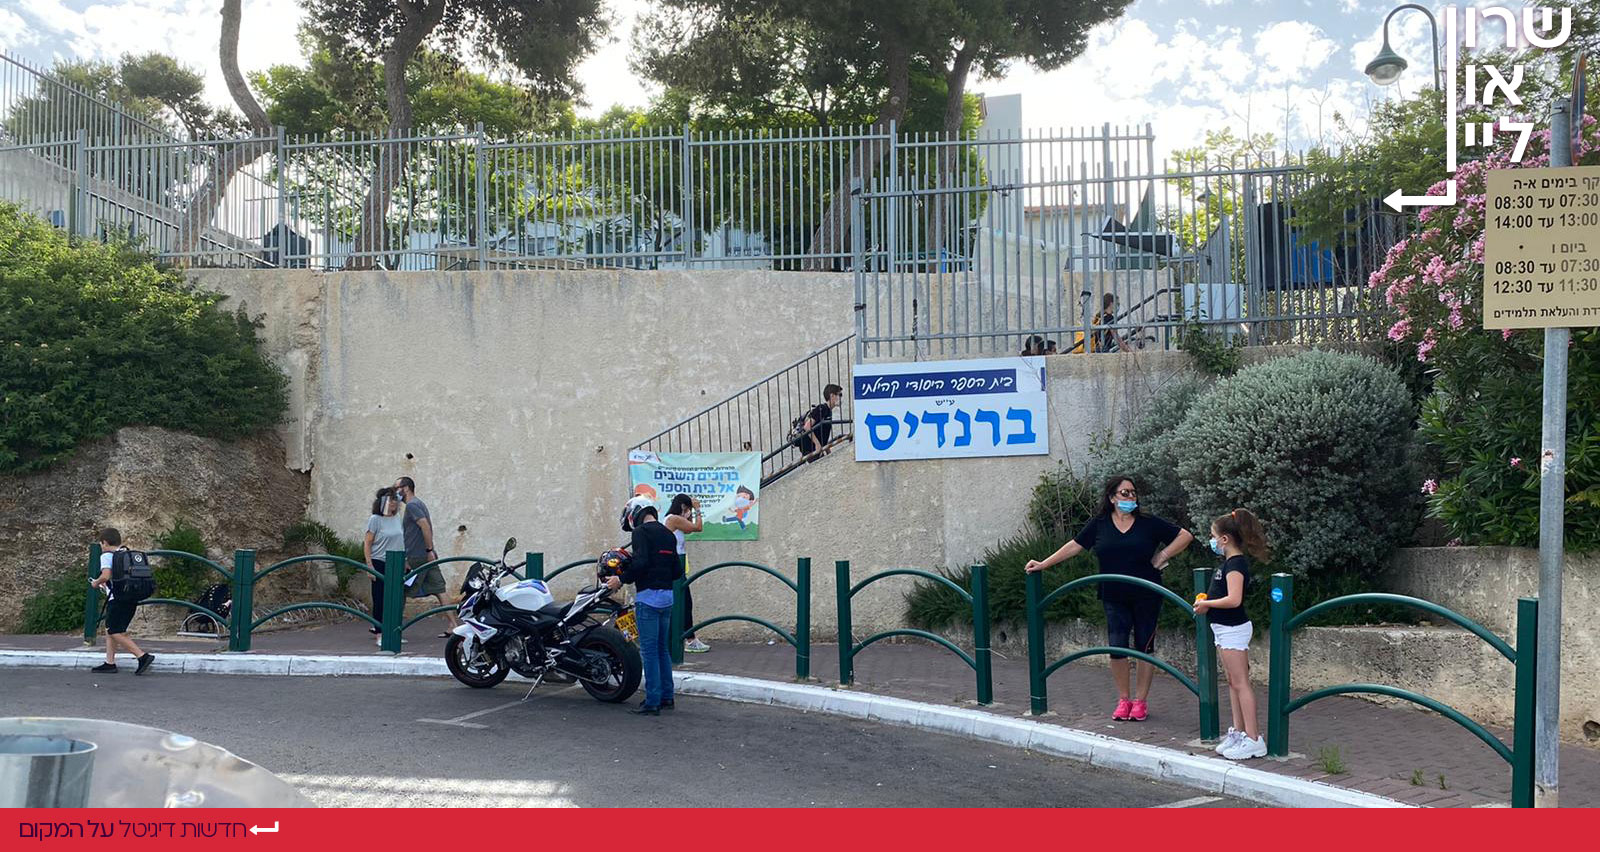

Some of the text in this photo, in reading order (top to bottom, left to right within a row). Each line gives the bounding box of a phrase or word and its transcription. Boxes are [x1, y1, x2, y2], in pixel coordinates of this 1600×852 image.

[1513, 178, 1537, 190] א-ה
[1541, 177, 1578, 189] בימים
[1494, 193, 1599, 210] 07:30 עד 08:30
[1494, 212, 1599, 229] 13:00 עד 14:00
[1561, 243, 1587, 253] ביום
[1495, 258, 1600, 275] 07:30 עד 08:30
[1493, 278, 1598, 294] 11:30 עד 12:30
[1493, 307, 1537, 318] תלמידים
[1540, 306, 1579, 318] והעלאת
[861, 376, 1014, 398] בית הספר היסודי קהילתי
[864, 406, 1037, 451] ברנדיס
[653, 470, 740, 481] ברוכים השבים
[658, 482, 735, 493] אל בית הספר
